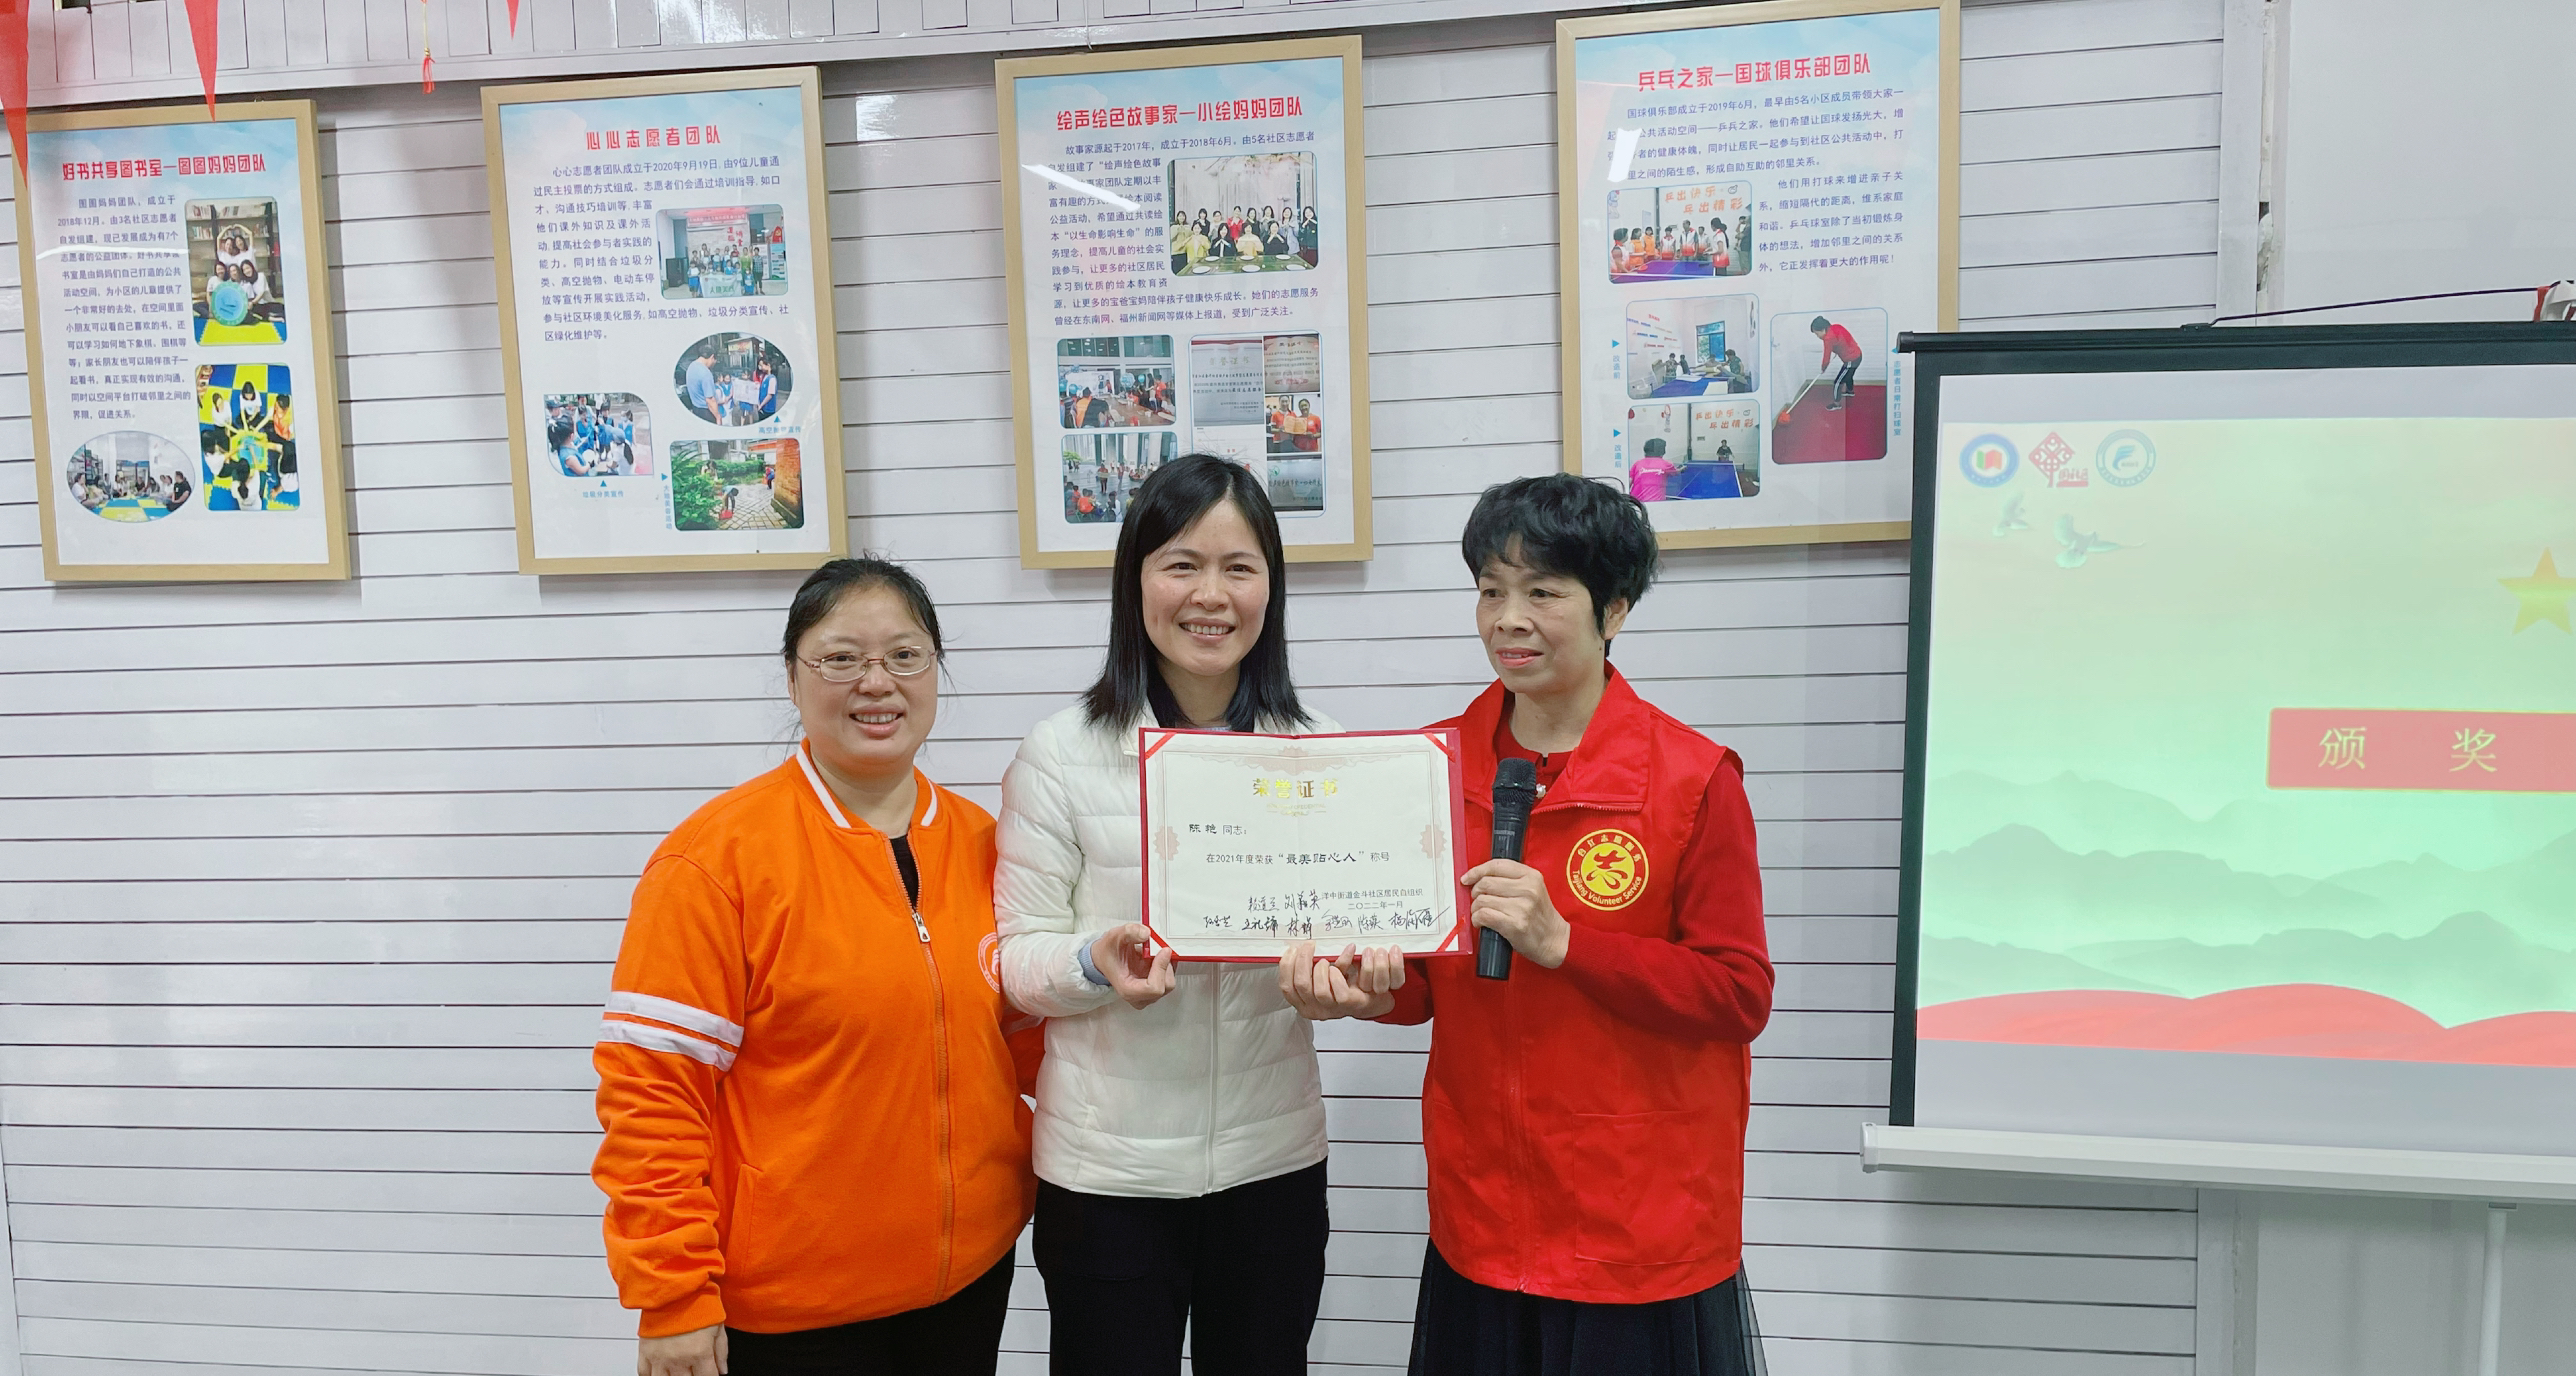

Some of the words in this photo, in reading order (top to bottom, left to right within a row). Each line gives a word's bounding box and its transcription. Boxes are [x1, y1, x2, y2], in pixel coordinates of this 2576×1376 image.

[586, 124, 721, 150] 心心志愿者团队
[536, 218, 652, 234] 他们课外知识及课外活
[1252, 778, 1338, 799] 荣誉证书
[1572, 869, 1589, 897] Taijiang
[1588, 893, 1624, 906] Volunteer
[1622, 876, 1642, 899] Service
